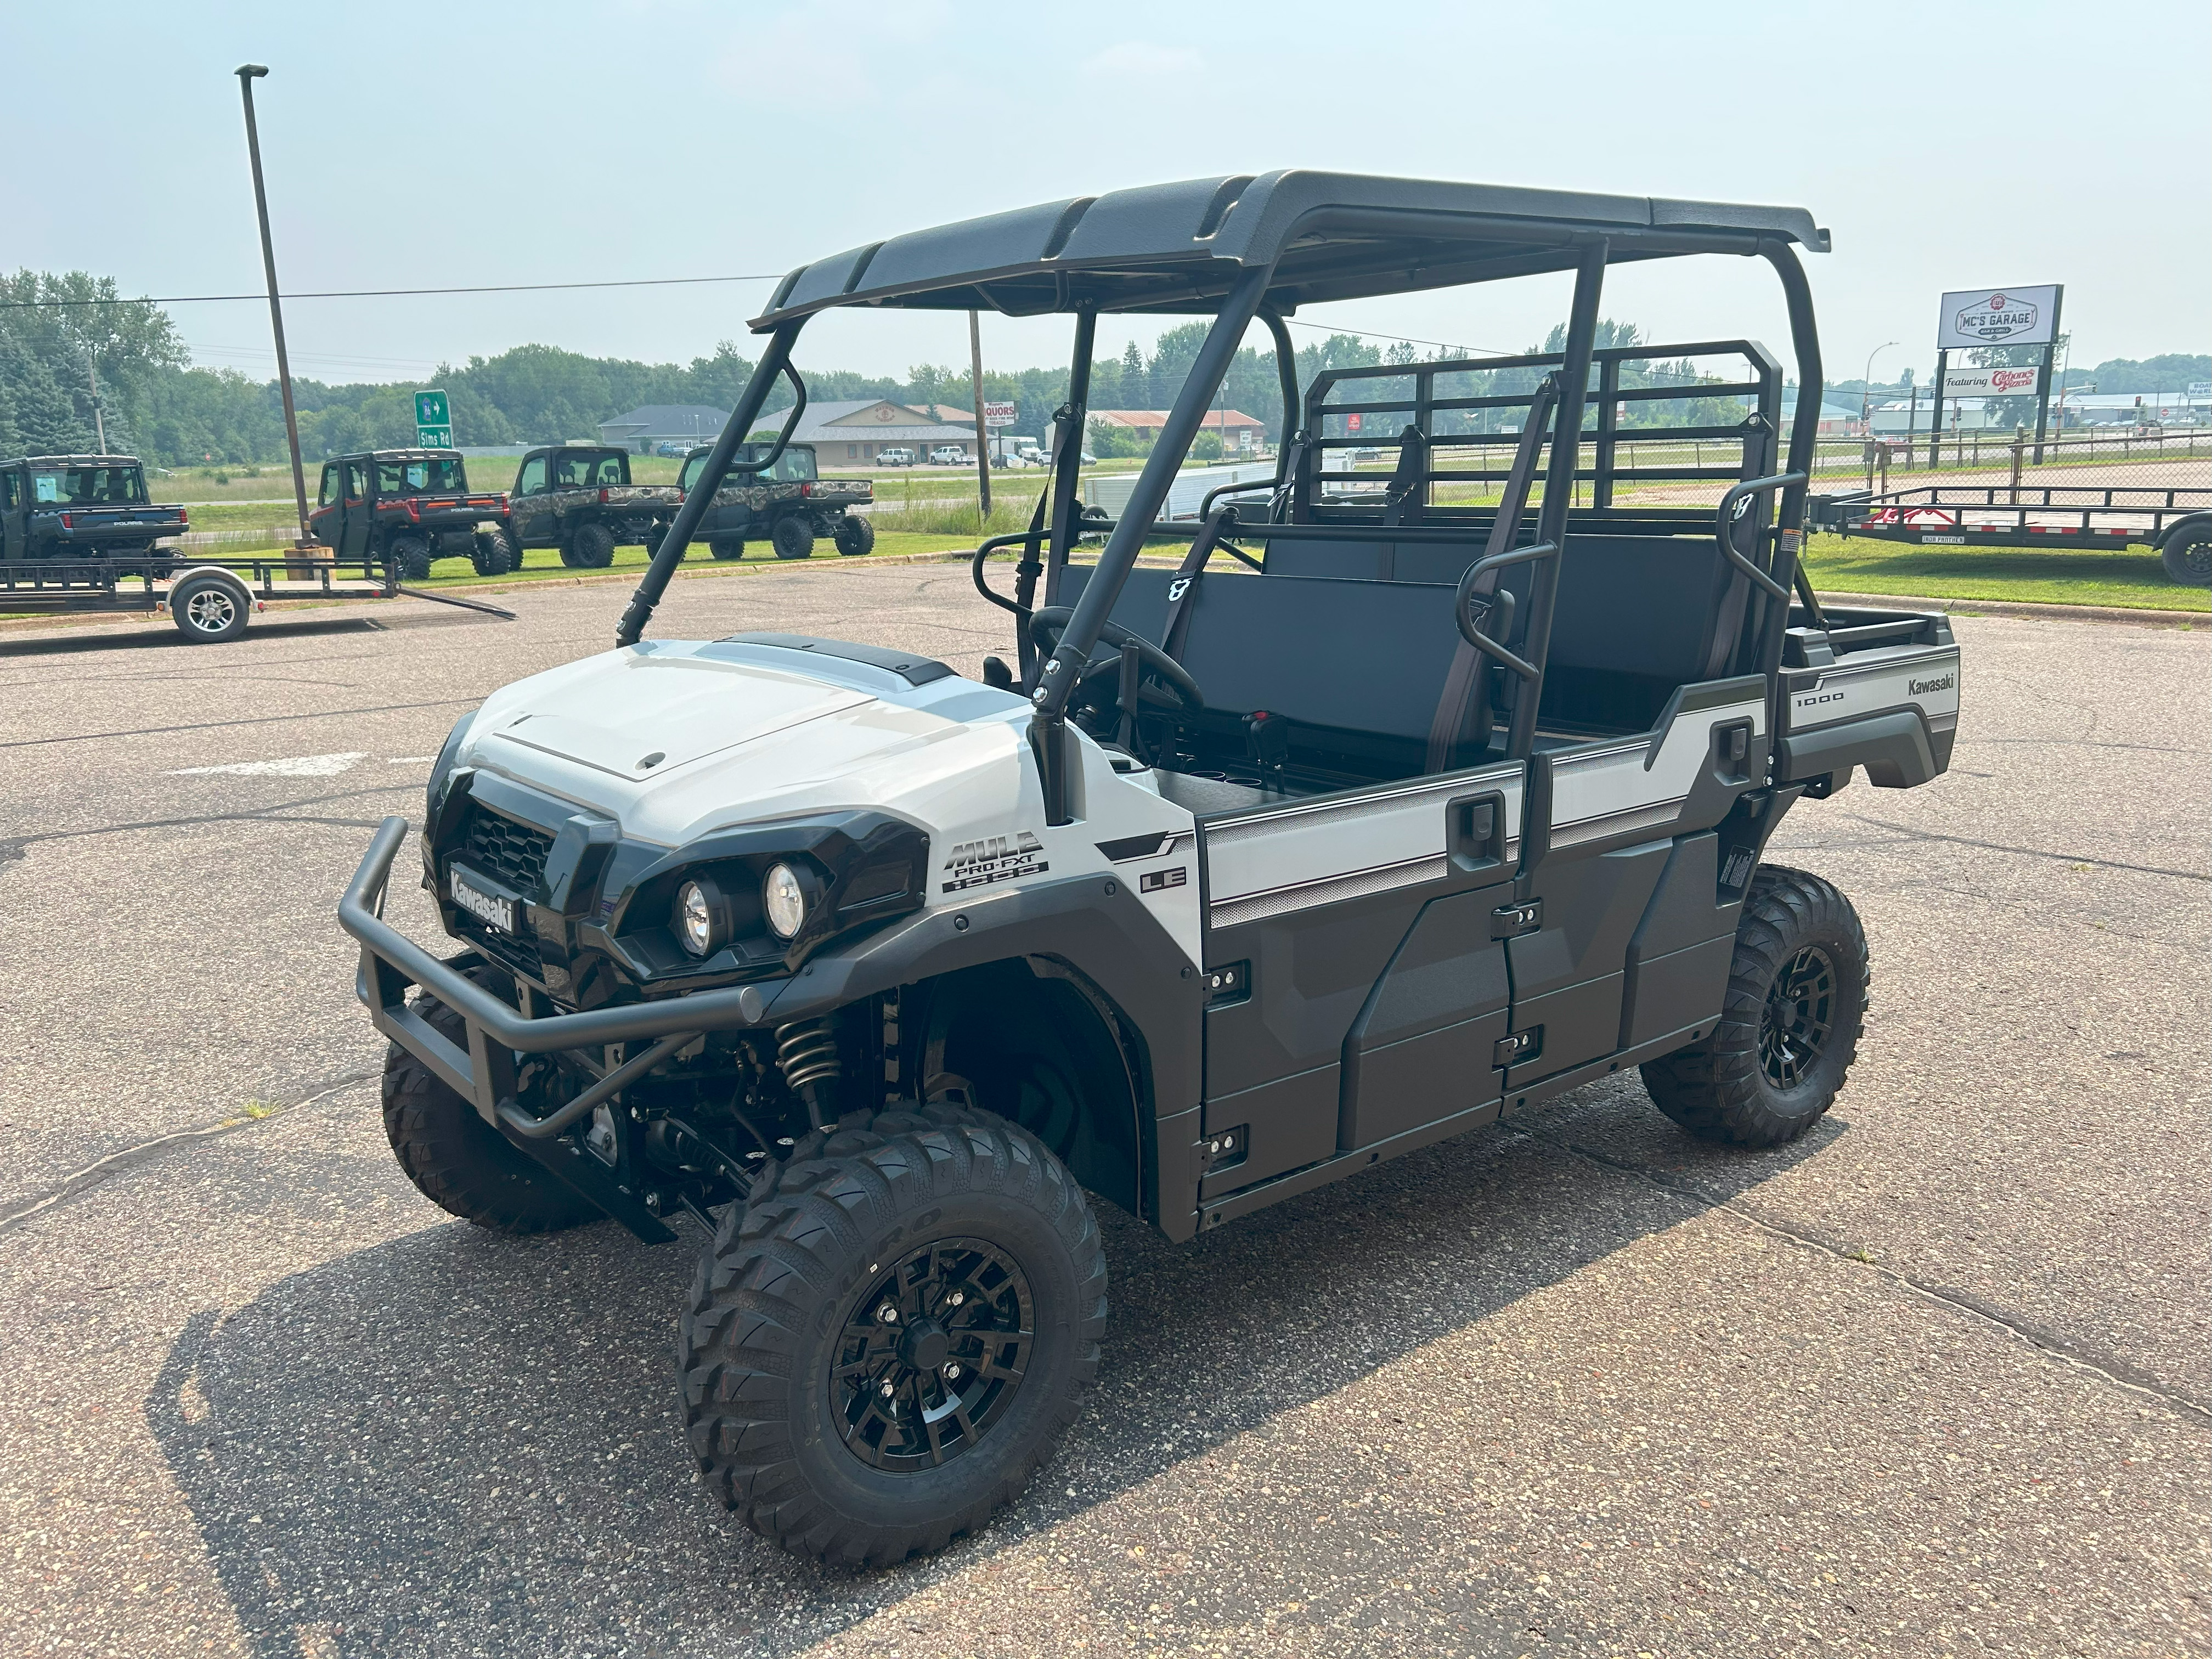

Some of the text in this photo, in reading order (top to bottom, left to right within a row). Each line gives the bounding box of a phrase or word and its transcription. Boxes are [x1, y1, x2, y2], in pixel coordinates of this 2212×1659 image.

[1962, 313, 2030, 327] MC'S GARAGE
[1945, 377, 1988, 387] Featuring
[984, 406, 1014, 416] IQUORS
[421, 432, 449, 445] Sims Rd
[1908, 673, 1954, 696] Kawasaki
[1797, 692, 1844, 707] 1000
[943, 831, 1044, 871] MULE
[955, 853, 1036, 878] PRO-FXT
[952, 864, 1040, 890] 1000
[1142, 869, 1185, 891] LE
[450, 870, 512, 932] Kawasaki
[815, 1206, 943, 1340] DURO
